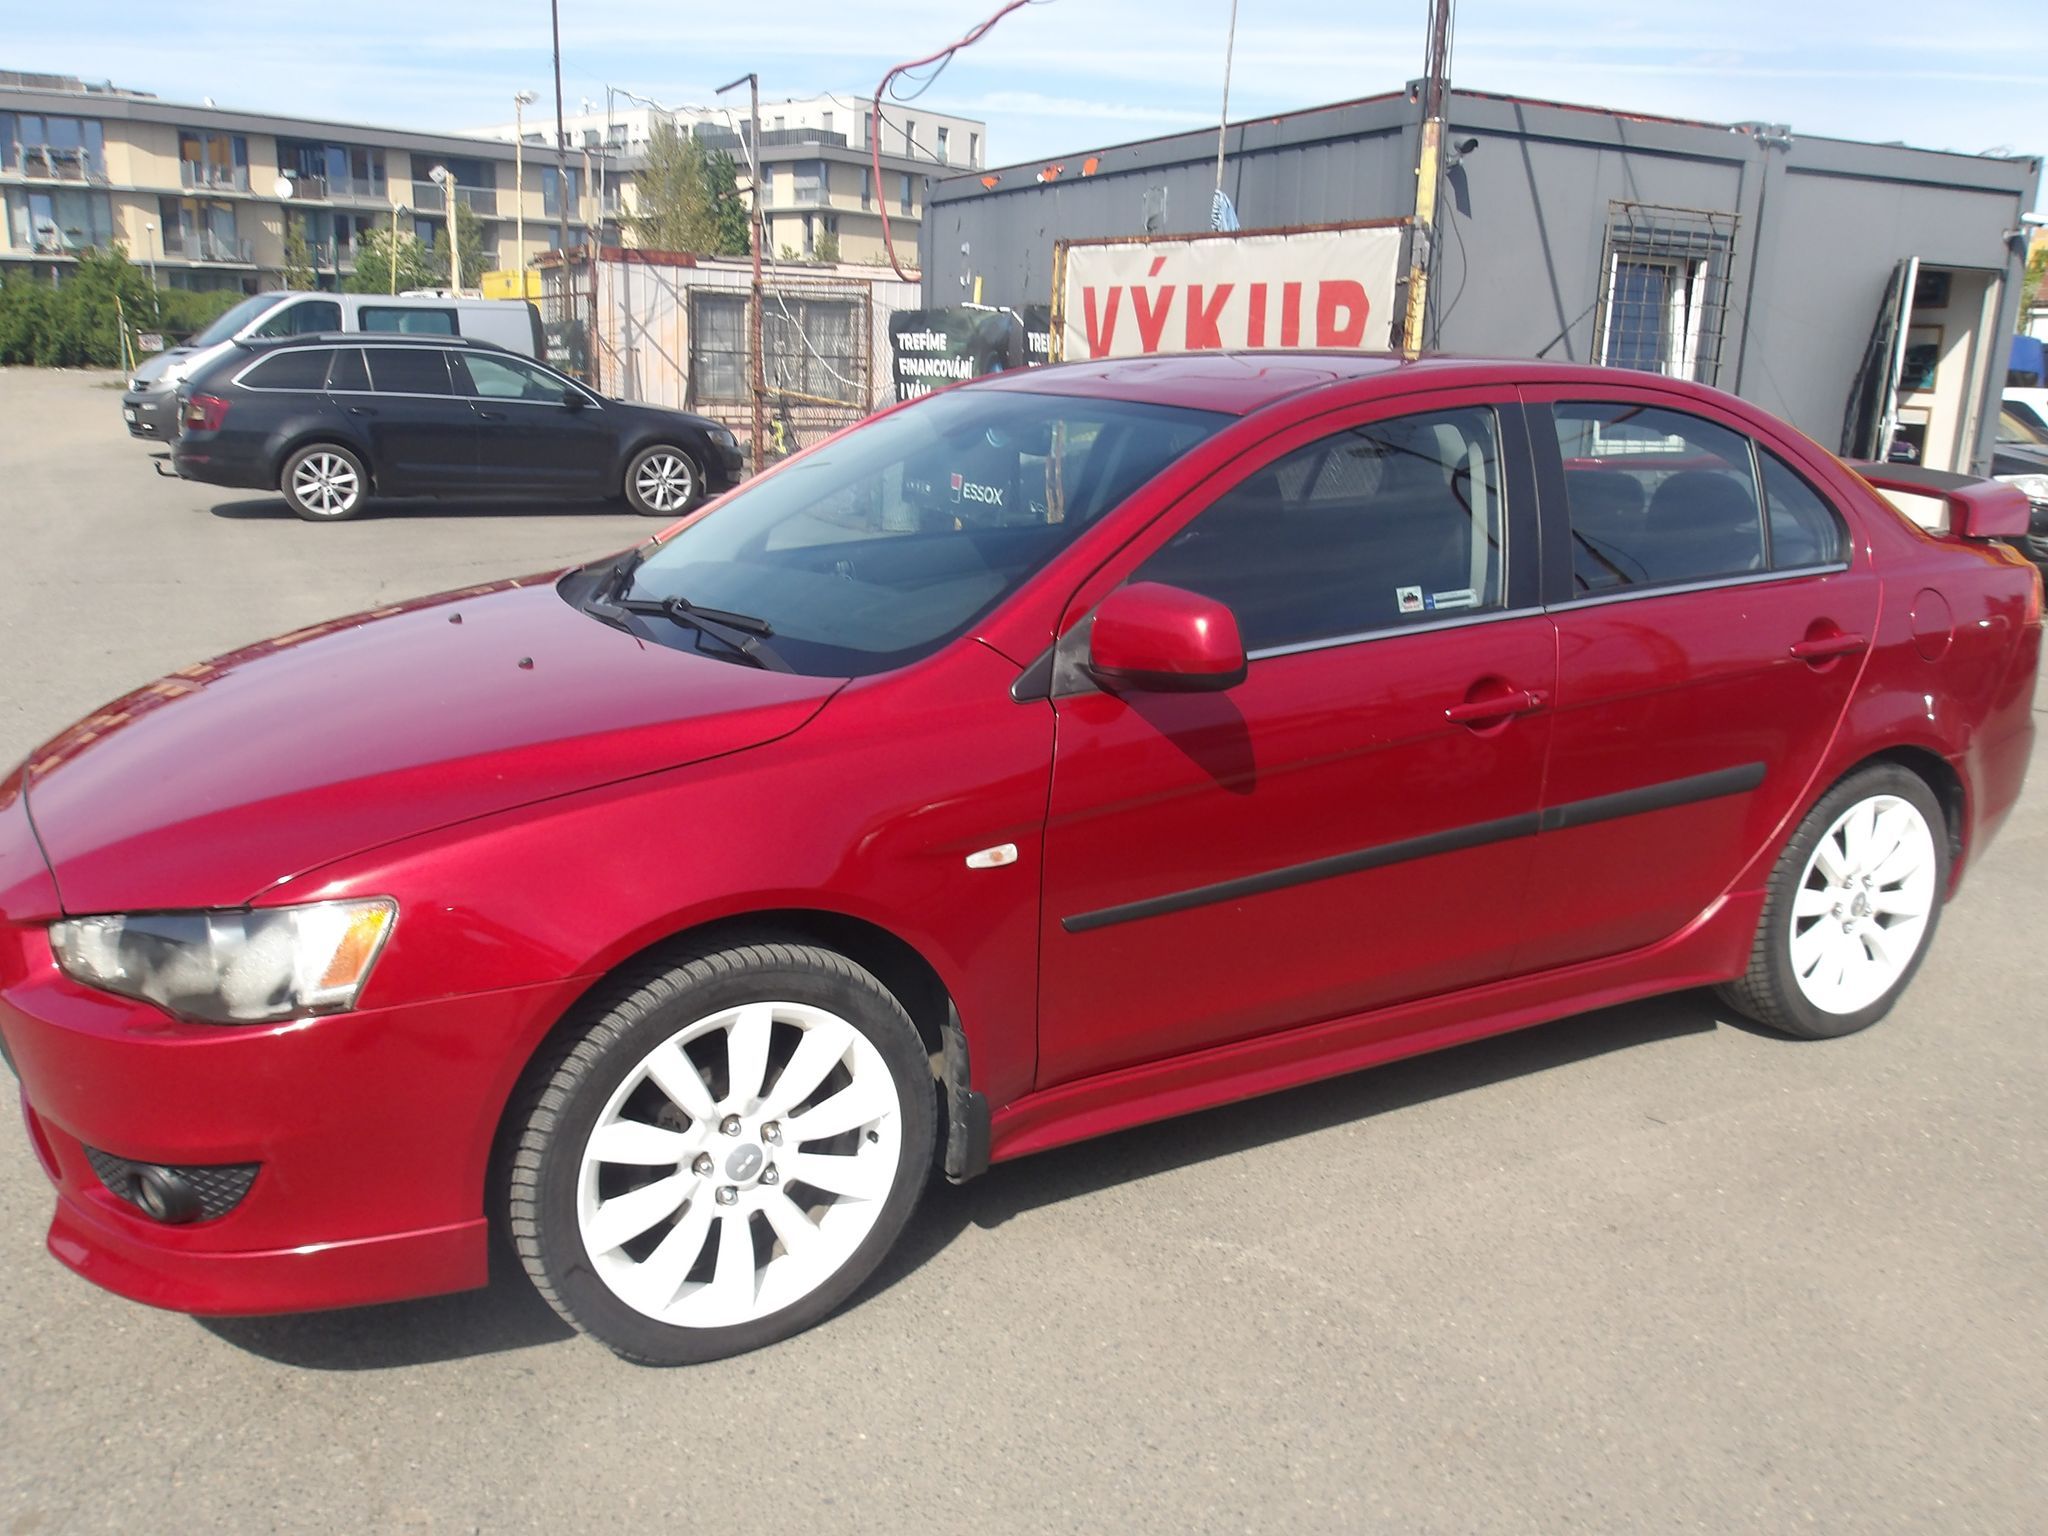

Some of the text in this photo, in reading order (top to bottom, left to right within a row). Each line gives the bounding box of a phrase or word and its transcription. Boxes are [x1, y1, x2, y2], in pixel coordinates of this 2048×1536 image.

[1083, 256, 1370, 359] VÝKUP
[897, 328, 947, 351] TREFÍME
[899, 355, 975, 380] FINANCOVÁNÍ
[963, 482, 1004, 506] ESSOX
